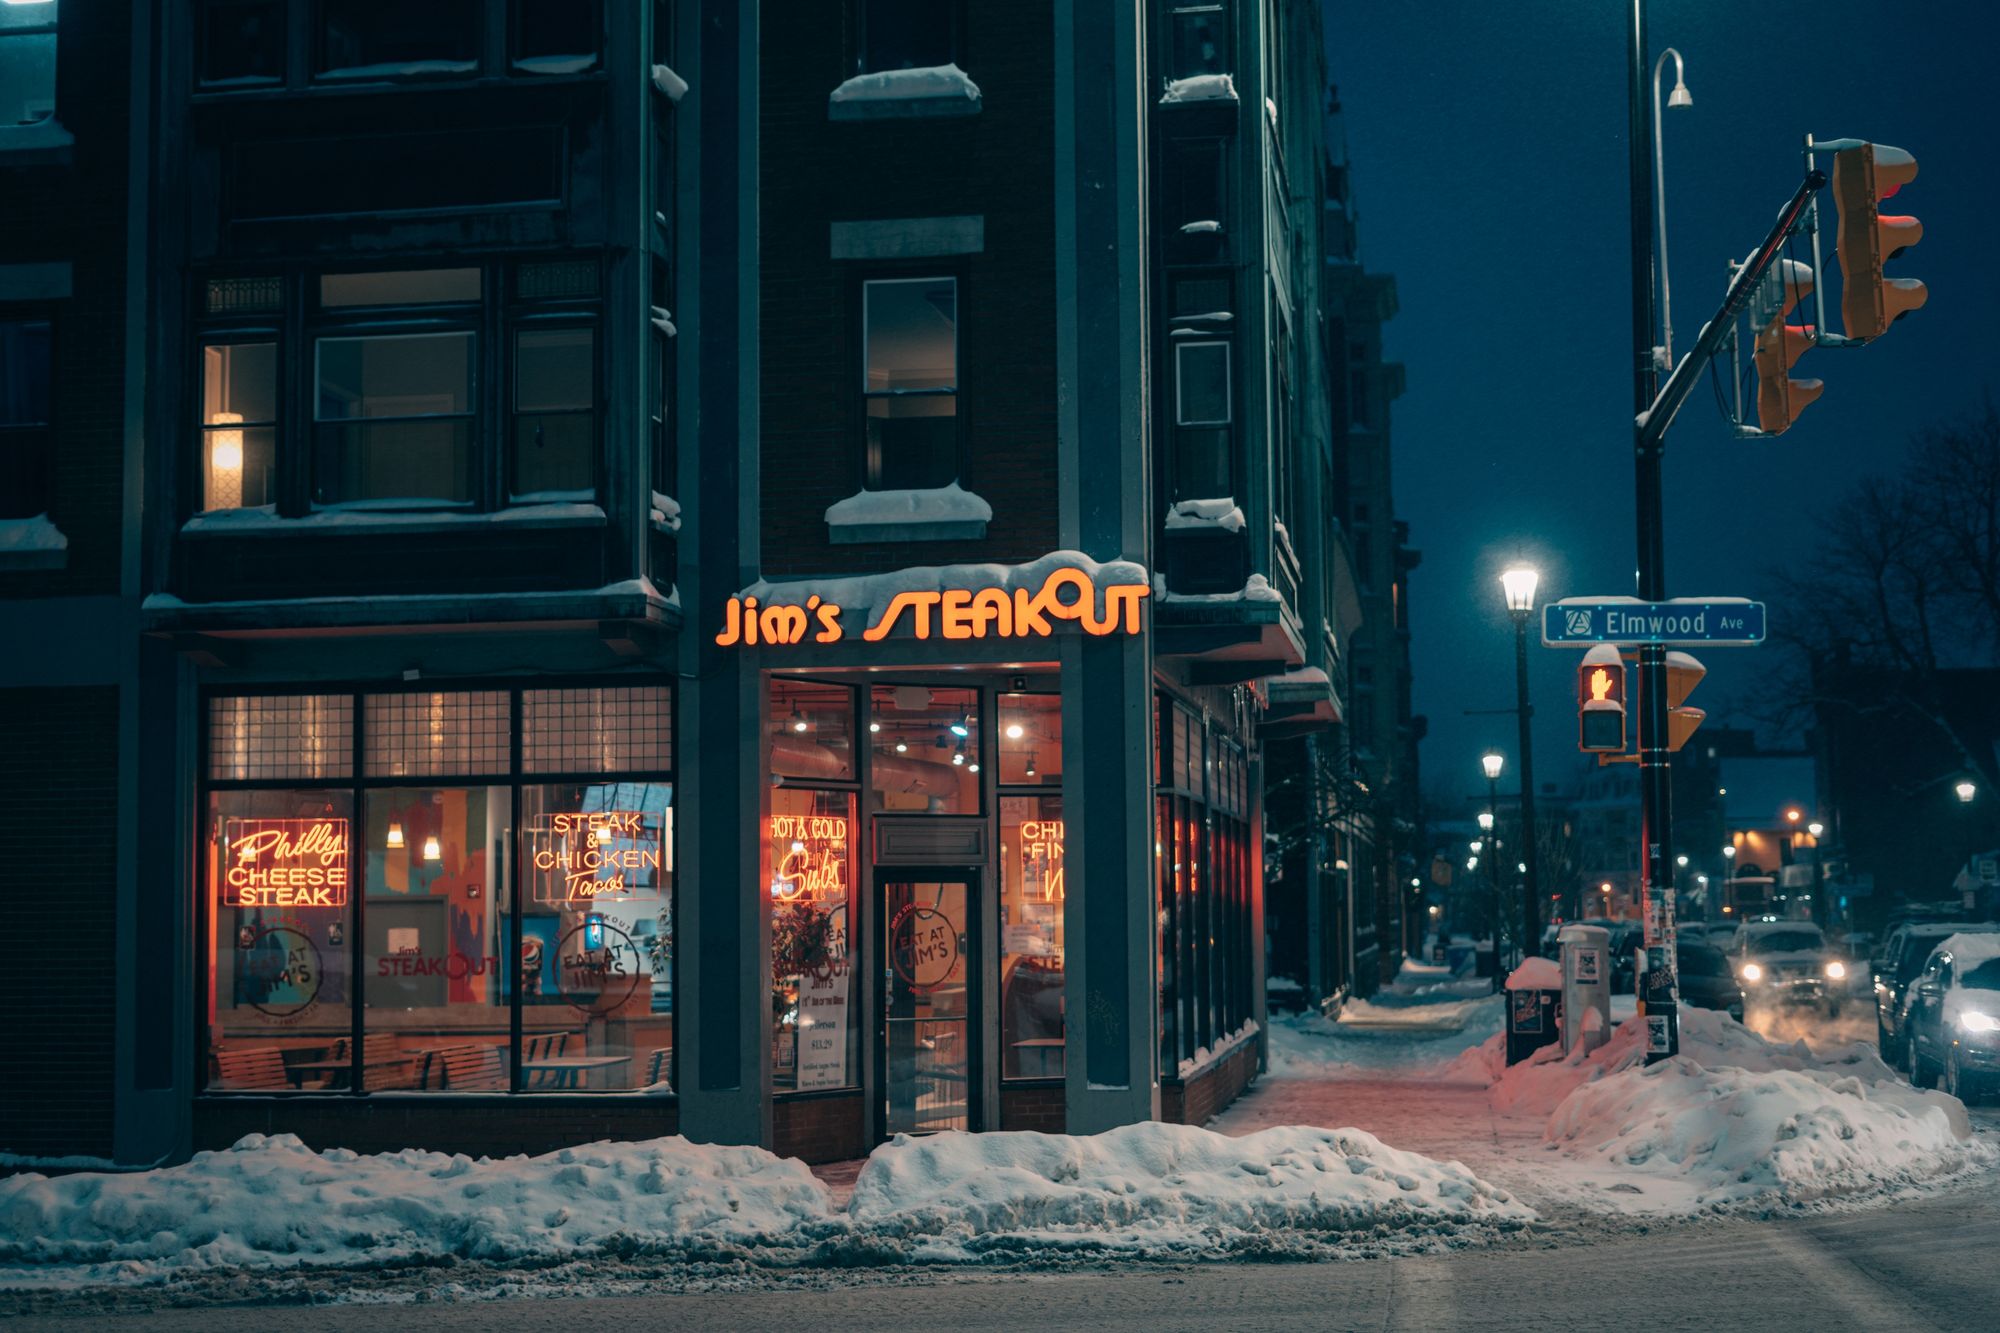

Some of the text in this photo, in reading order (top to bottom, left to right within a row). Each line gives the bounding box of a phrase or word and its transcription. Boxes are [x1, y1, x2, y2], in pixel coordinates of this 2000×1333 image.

[1607, 612, 1744, 634] Elmwood Ave
[554, 814, 641, 832] STEAK
[812, 818, 847, 839] COLD
[231, 823, 345, 867] Philly
[587, 832, 599, 848] &
[536, 850, 660, 869] CHICKEN
[228, 867, 345, 886] CHEESE
[780, 847, 839, 900] Subs
[565, 869, 624, 901] Tacos
[239, 887, 332, 906] STEAK
[900, 926, 945, 948] EAT AT
[288, 946, 307, 965] AT
[377, 952, 498, 980] STEAKOUT
[563, 944, 622, 970] EAT AT
[906, 941, 948, 969] JIM'S
